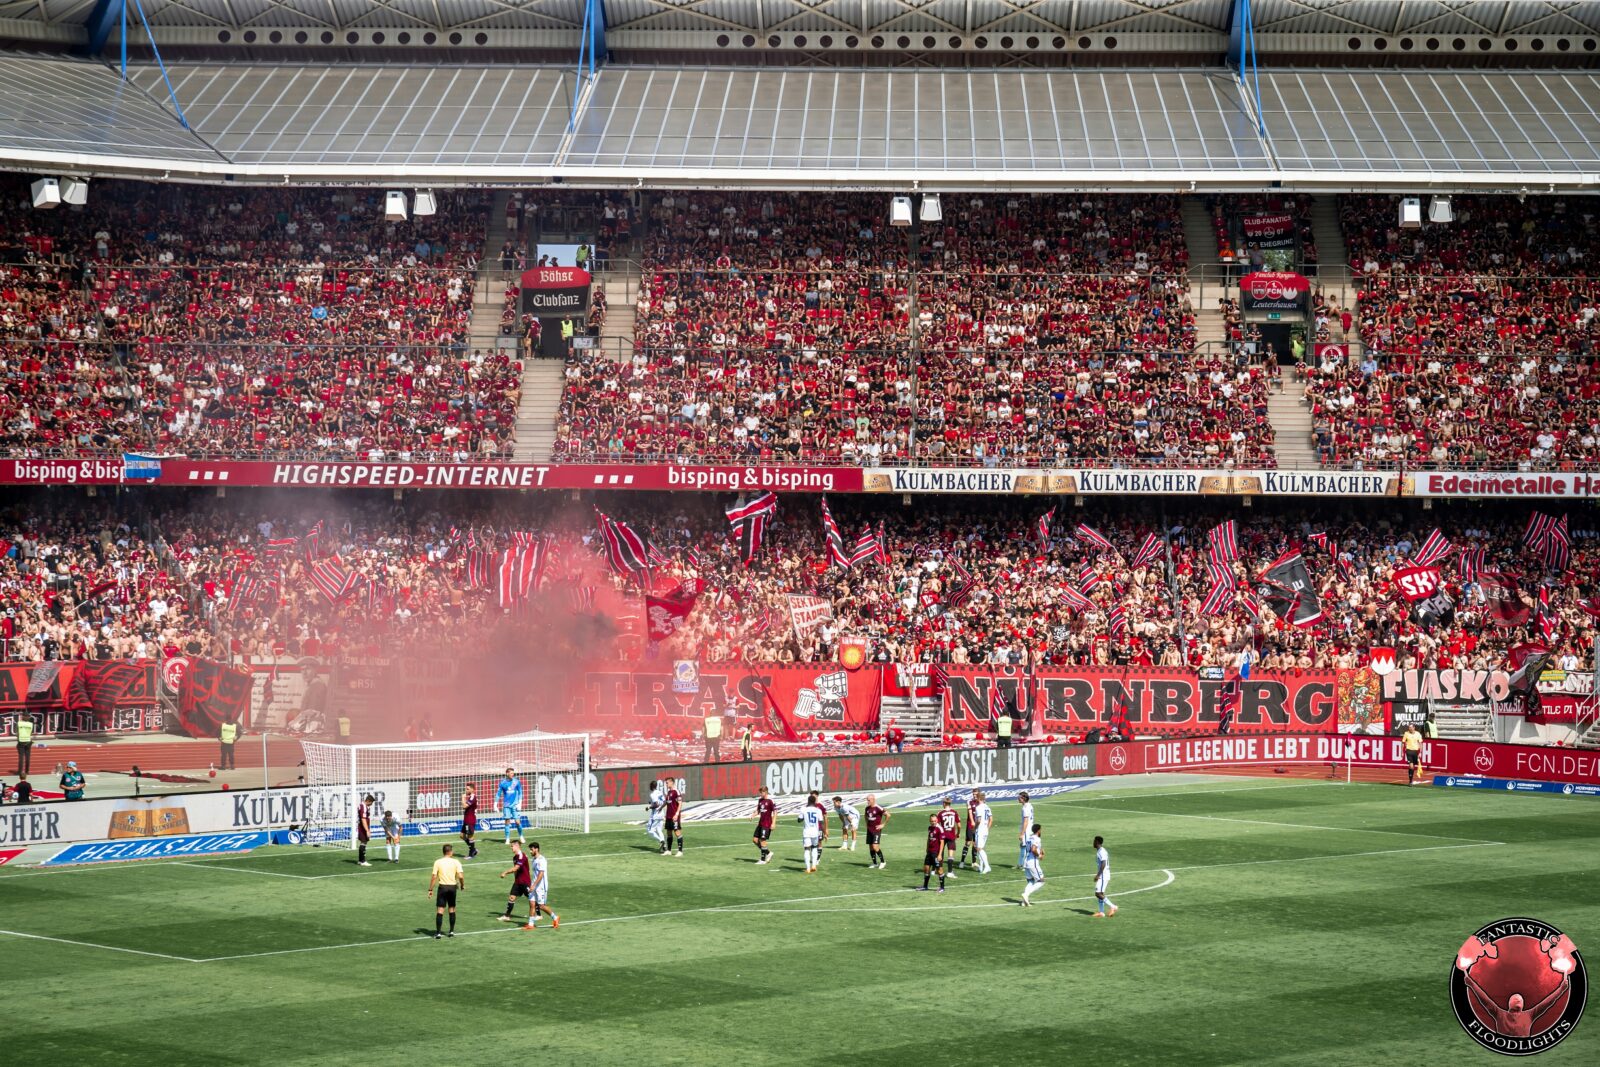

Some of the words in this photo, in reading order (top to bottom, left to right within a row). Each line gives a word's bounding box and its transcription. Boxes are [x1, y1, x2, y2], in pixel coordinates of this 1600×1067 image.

[1244, 215, 1292, 225] CLUB-FANATICS
[540, 271, 573, 282] Böhse
[533, 294, 580, 307] Clubfanz
[15, 461, 77, 483] bisping
[96, 461, 155, 483] bisp
[273, 464, 549, 486] HIGHSPEED-INTERNET
[668, 467, 740, 489] bisping
[743, 468, 758, 485] &
[762, 468, 834, 490] bisping
[895, 469, 1012, 491] KULMBACHER
[1079, 470, 1197, 492] KULMBACHER
[1265, 472, 1383, 494] KULMBACHER
[947, 666, 1336, 725] NÜRNBERG
[1383, 669, 1511, 702] FIASKO
[1404, 704, 1419, 713] YOU
[1158, 743, 1181, 764] DIE
[1186, 739, 1257, 762] LEGENDE
[1264, 738, 1310, 759] LEBT
[1317, 738, 1384, 760] DURCH
[1392, 740, 1432, 763] DH
[921, 750, 998, 786] CLASSIC
[1007, 746, 1053, 781] ROCK
[1063, 755, 1089, 771] GONG
[1517, 752, 1600, 776] FCN.DE/
[766, 760, 825, 795] GONG
[828, 758, 863, 790] 97.1
[876, 766, 904, 783] GONG
[417, 791, 450, 810] GONG
[537, 773, 598, 809] GONG
[604, 771, 641, 806] 97.1
[806, 811, 817, 824] 15
[943, 815, 955, 829] 20
